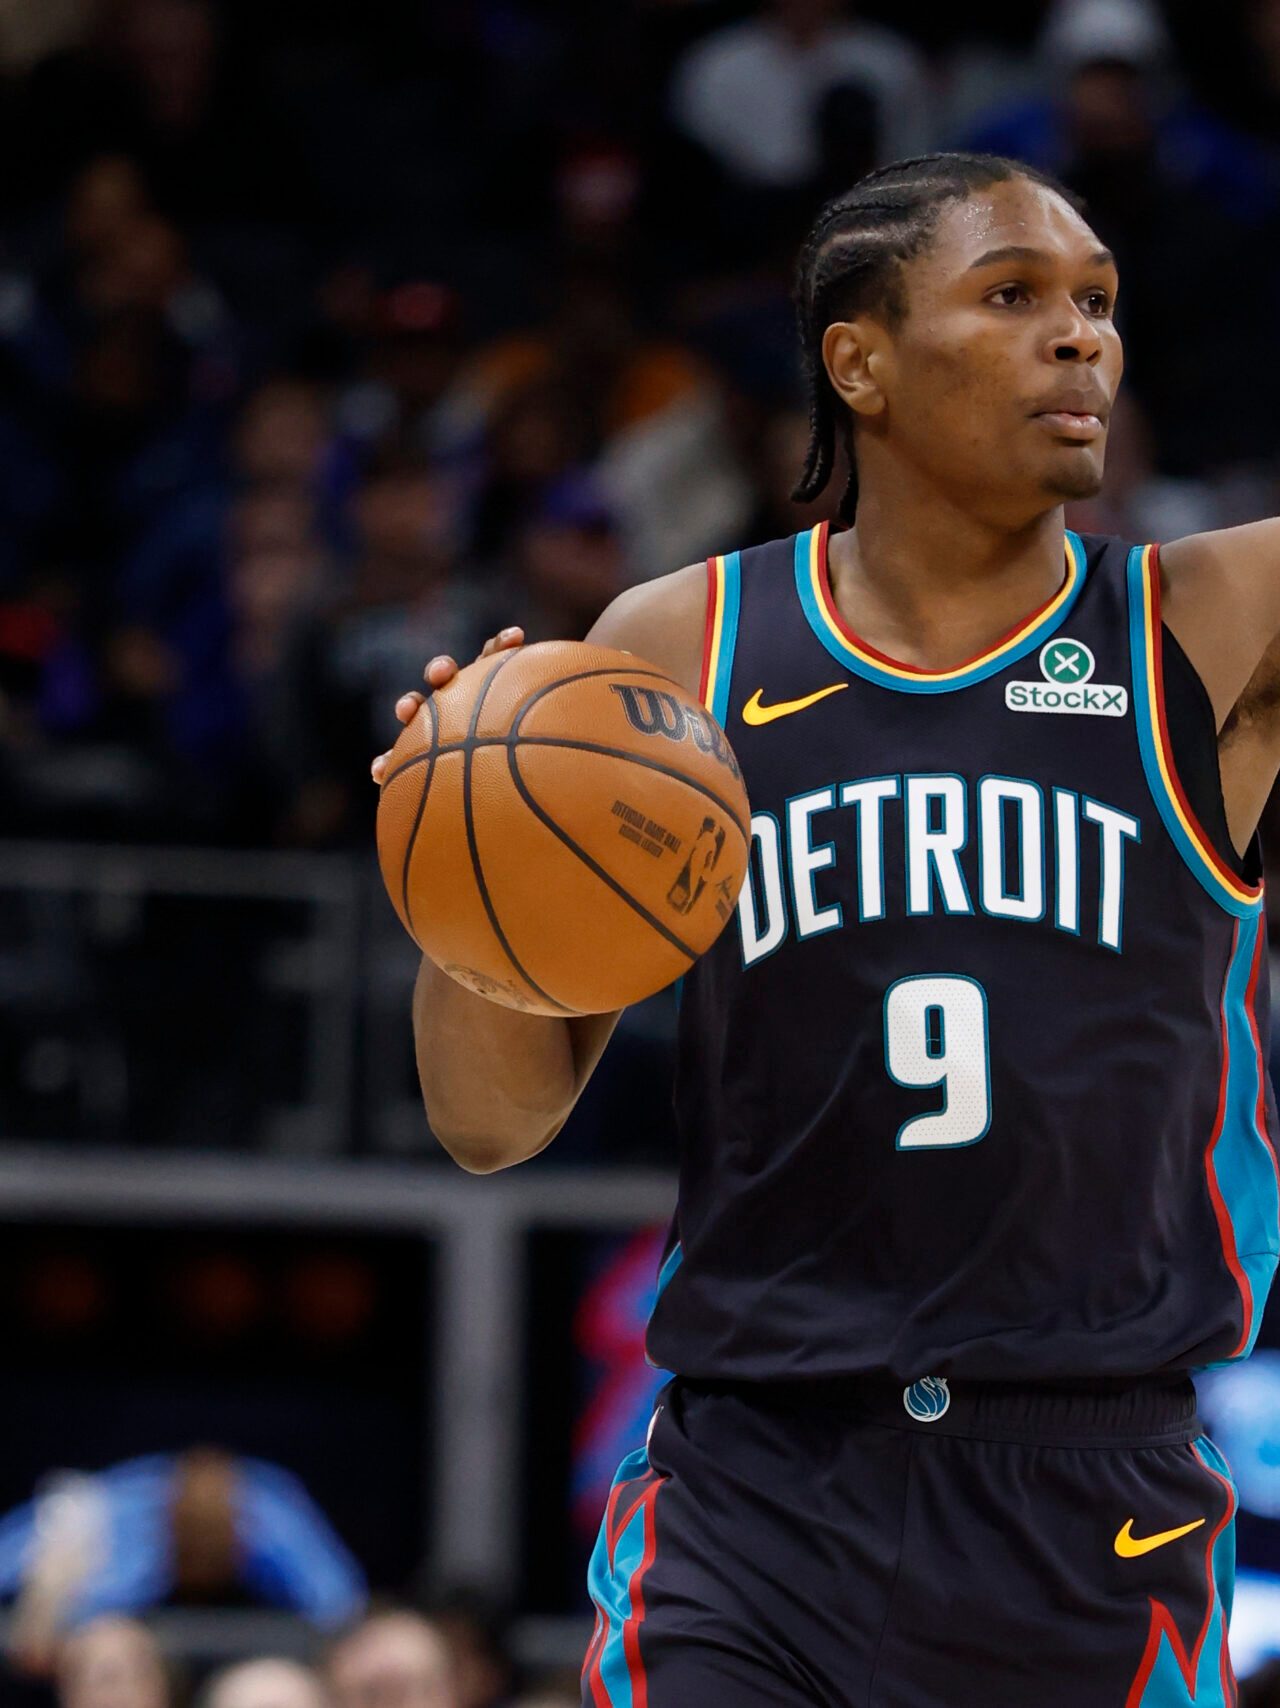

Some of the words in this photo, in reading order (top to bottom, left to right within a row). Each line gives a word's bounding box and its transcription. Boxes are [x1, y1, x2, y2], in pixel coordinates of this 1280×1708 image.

[1009, 685, 1123, 712] StockX
[737, 773, 1141, 972] DETROIT
[883, 973, 992, 1151] 9
